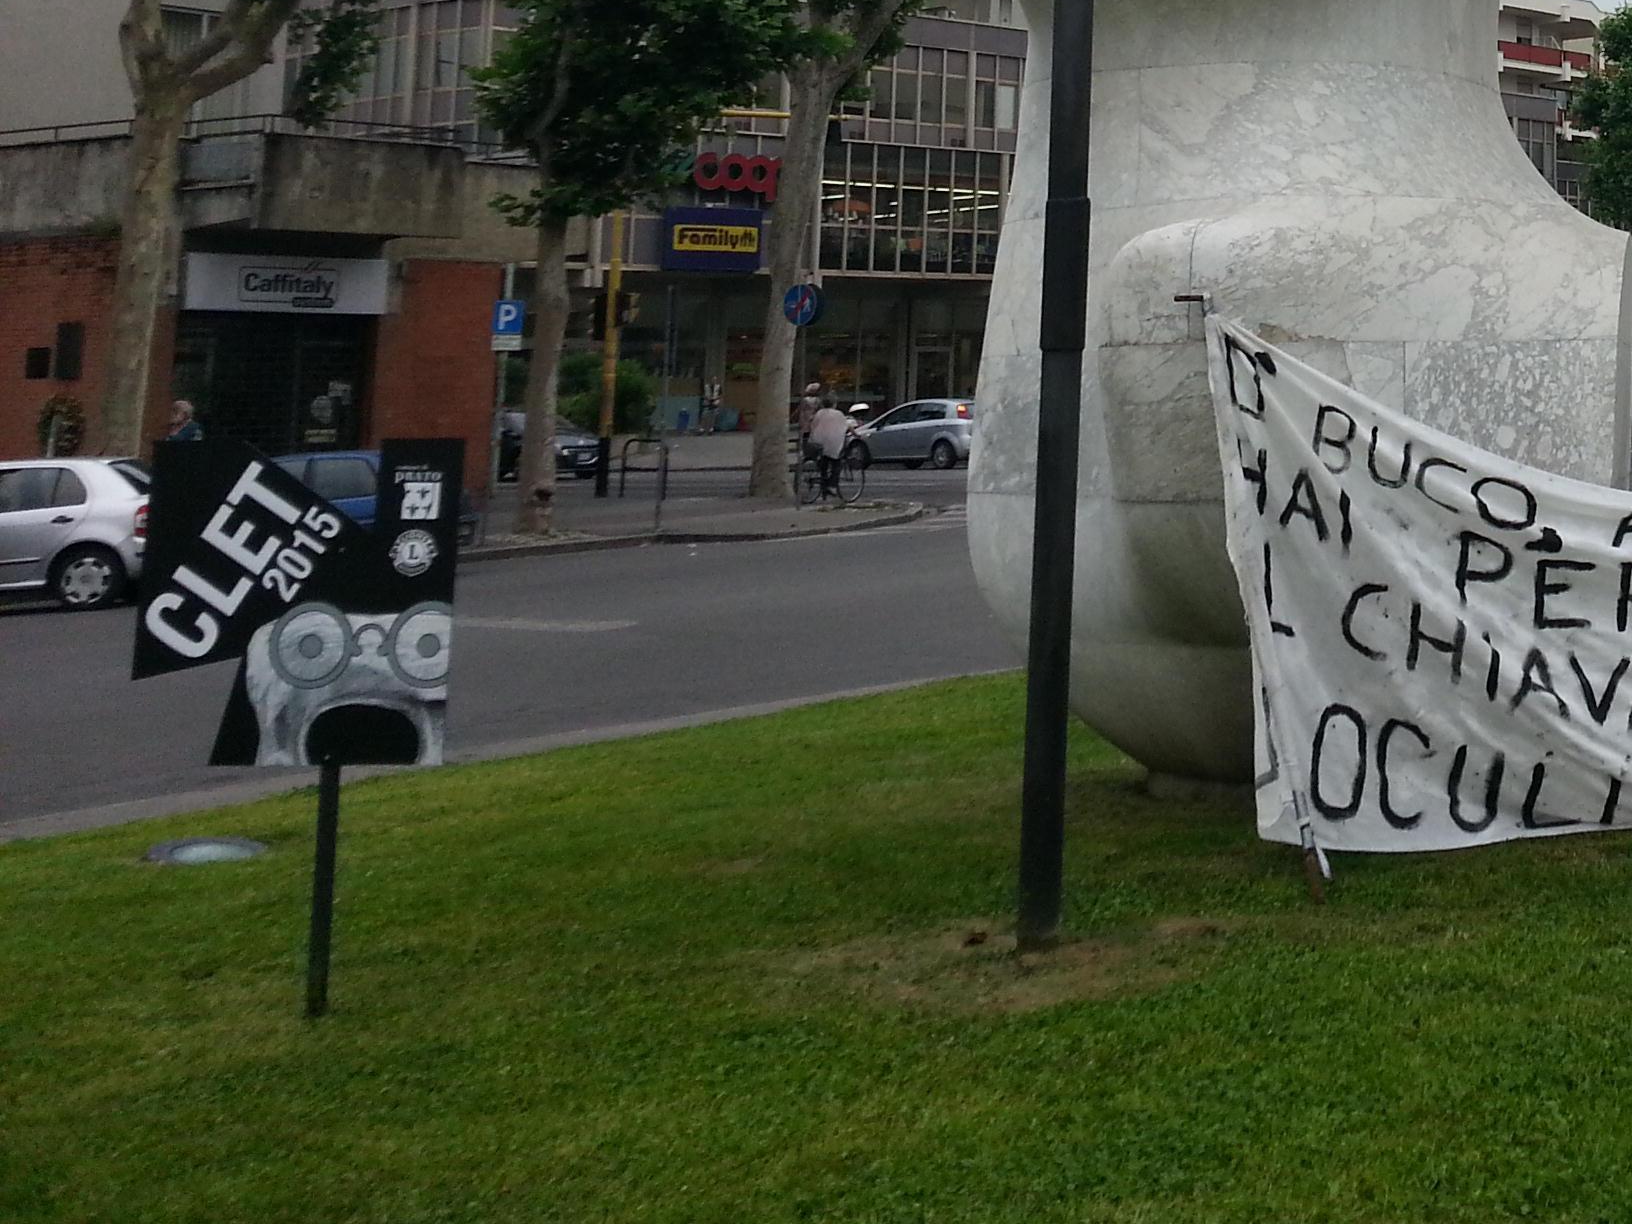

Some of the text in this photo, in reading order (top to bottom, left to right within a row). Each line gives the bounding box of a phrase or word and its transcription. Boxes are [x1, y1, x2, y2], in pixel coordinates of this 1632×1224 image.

[678, 227, 740, 249] Family
[244, 272, 334, 299] Caffitaly
[498, 304, 517, 330] P
[1237, 433, 1353, 557] HAI
[145, 460, 301, 659] CLET
[261, 505, 341, 603] 2015
